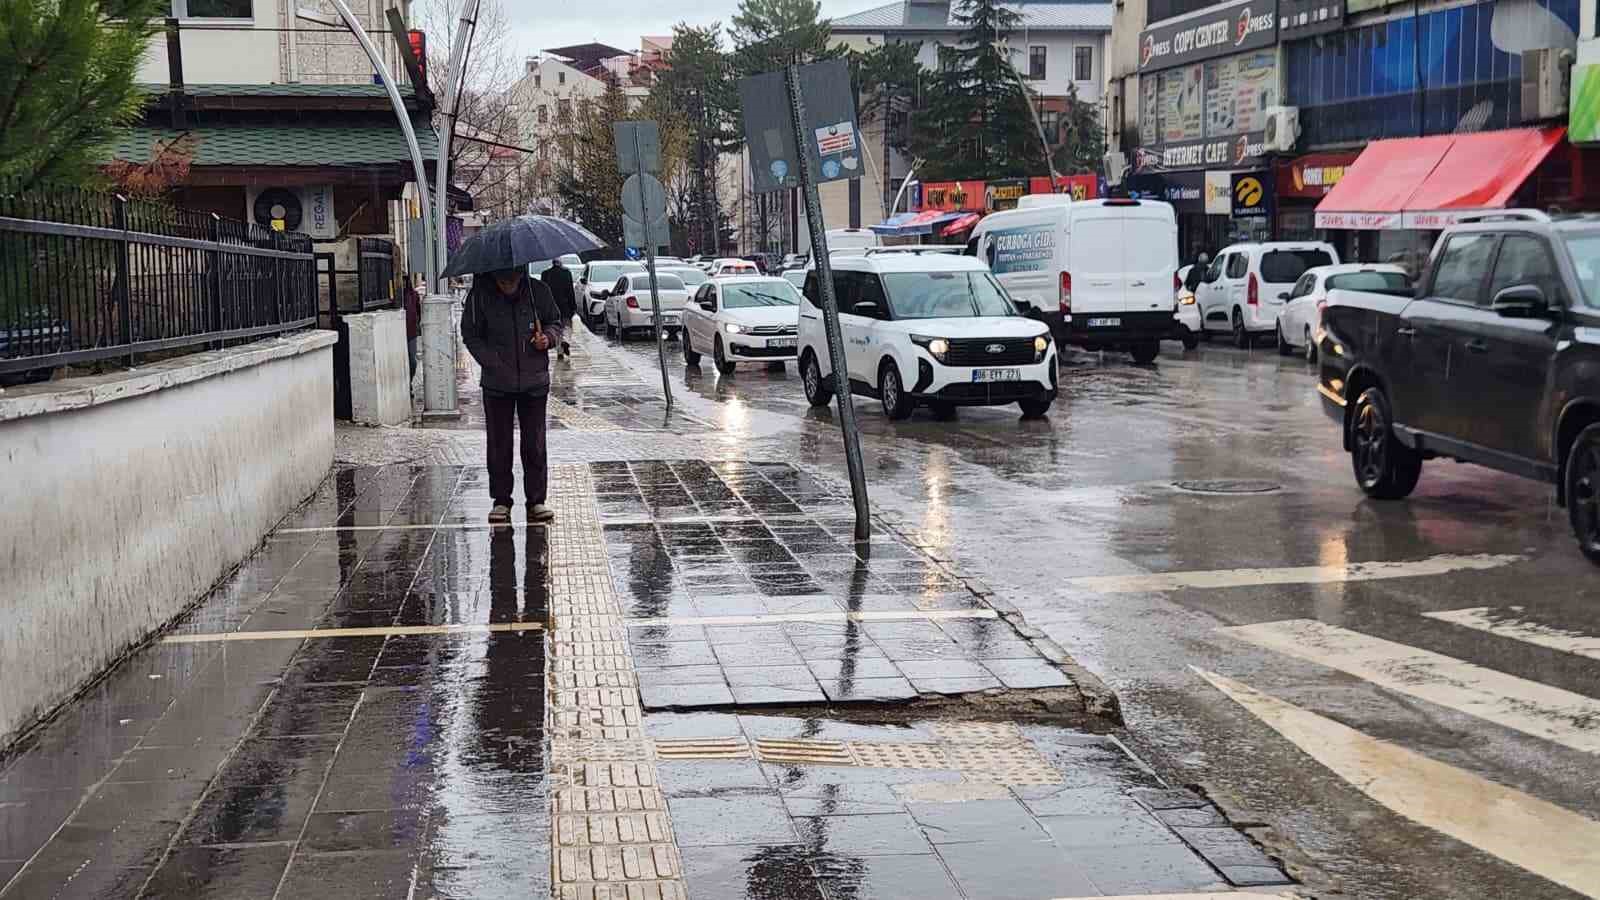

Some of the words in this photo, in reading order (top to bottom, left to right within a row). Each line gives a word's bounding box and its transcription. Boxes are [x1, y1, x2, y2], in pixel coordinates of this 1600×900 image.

[1174, 30, 1195, 54] COPY
[1195, 20, 1230, 49] CENTER
[1163, 144, 1204, 167] INTERNET
[1205, 142, 1228, 163] CAFE
